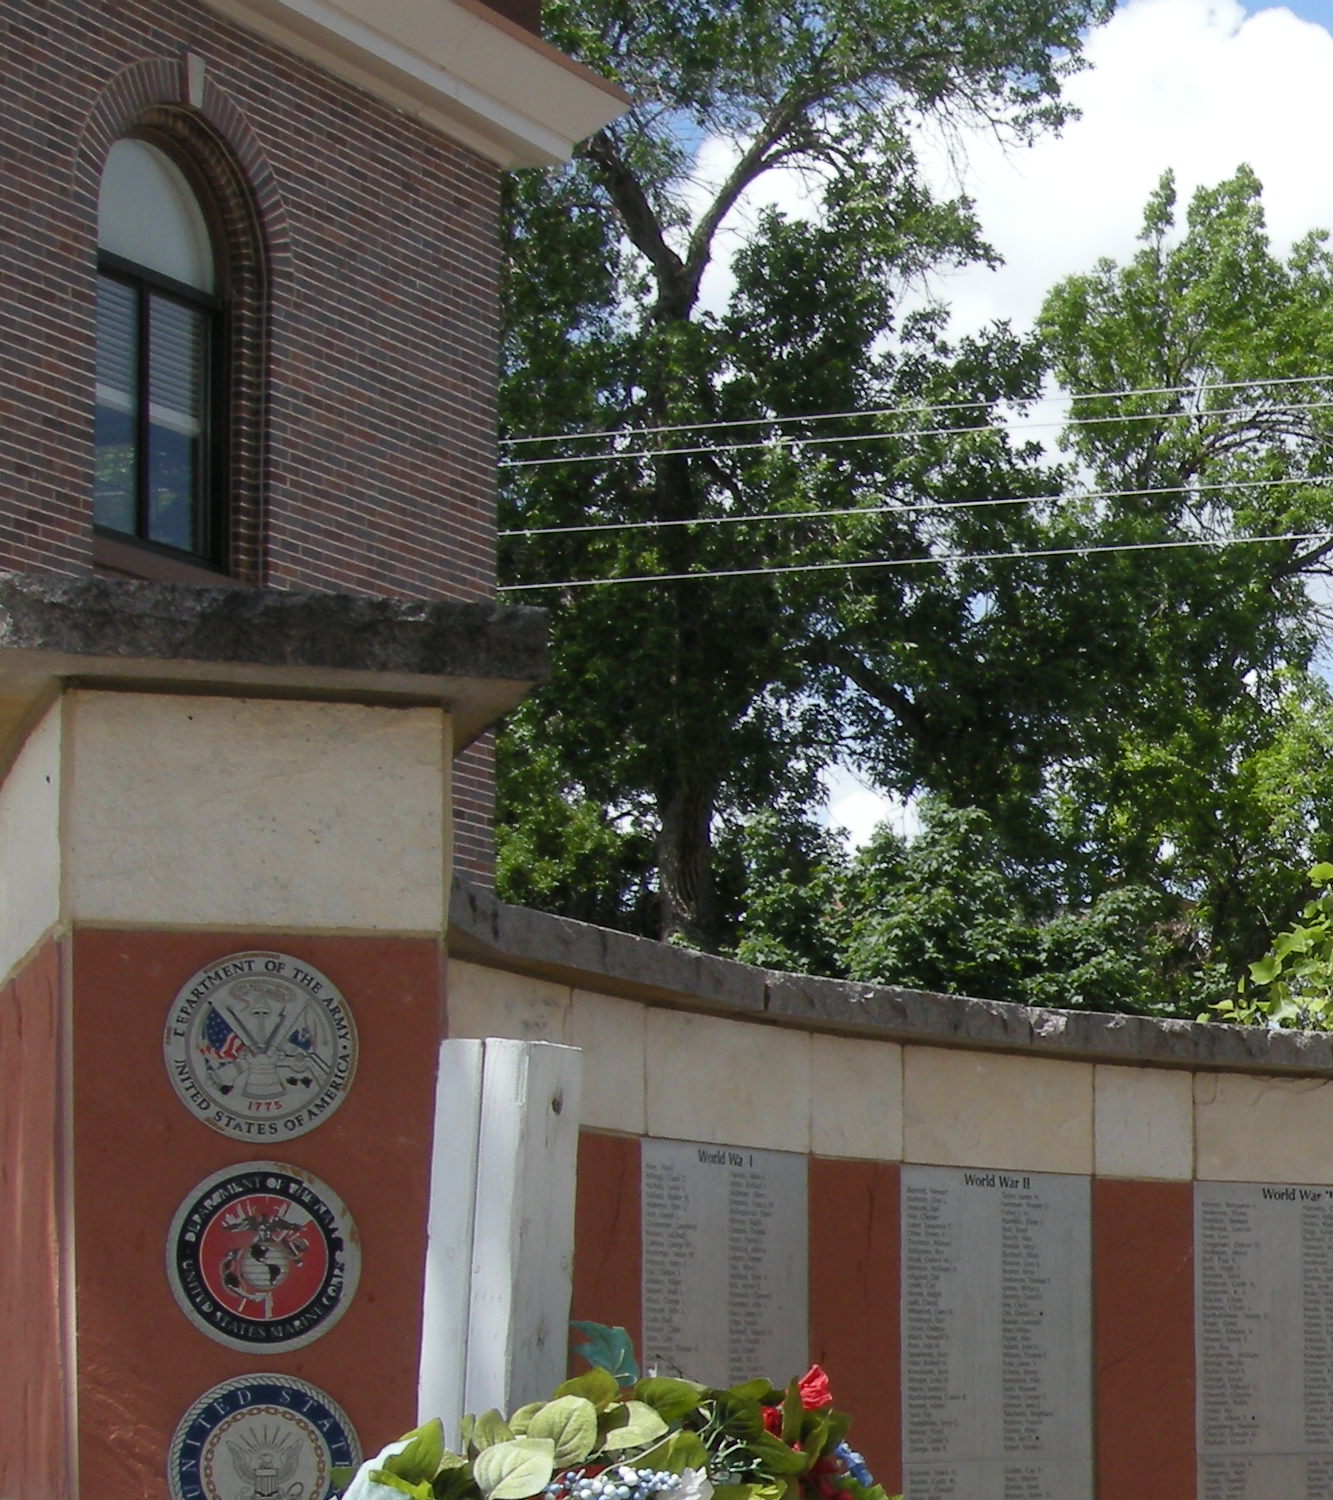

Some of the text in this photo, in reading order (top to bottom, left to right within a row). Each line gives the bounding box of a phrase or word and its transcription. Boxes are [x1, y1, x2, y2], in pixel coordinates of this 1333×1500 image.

[264, 959, 285, 974] OF
[293, 968, 323, 994] THE
[322, 995, 350, 1038] ARMY
[215, 1110, 278, 1135] STATES
[284, 1116, 304, 1132] OF
[308, 1054, 350, 1122] AMERICA
[248, 1101, 282, 1112] 1775
[698, 1149, 726, 1165] World
[964, 1173, 1030, 1189] World War II
[1262, 1188, 1295, 1201] World
[1299, 1190, 1322, 1202] War
[182, 1260, 214, 1313] UNITED
[215, 1310, 267, 1338] STATES
[182, 1389, 251, 1498] UNITED
